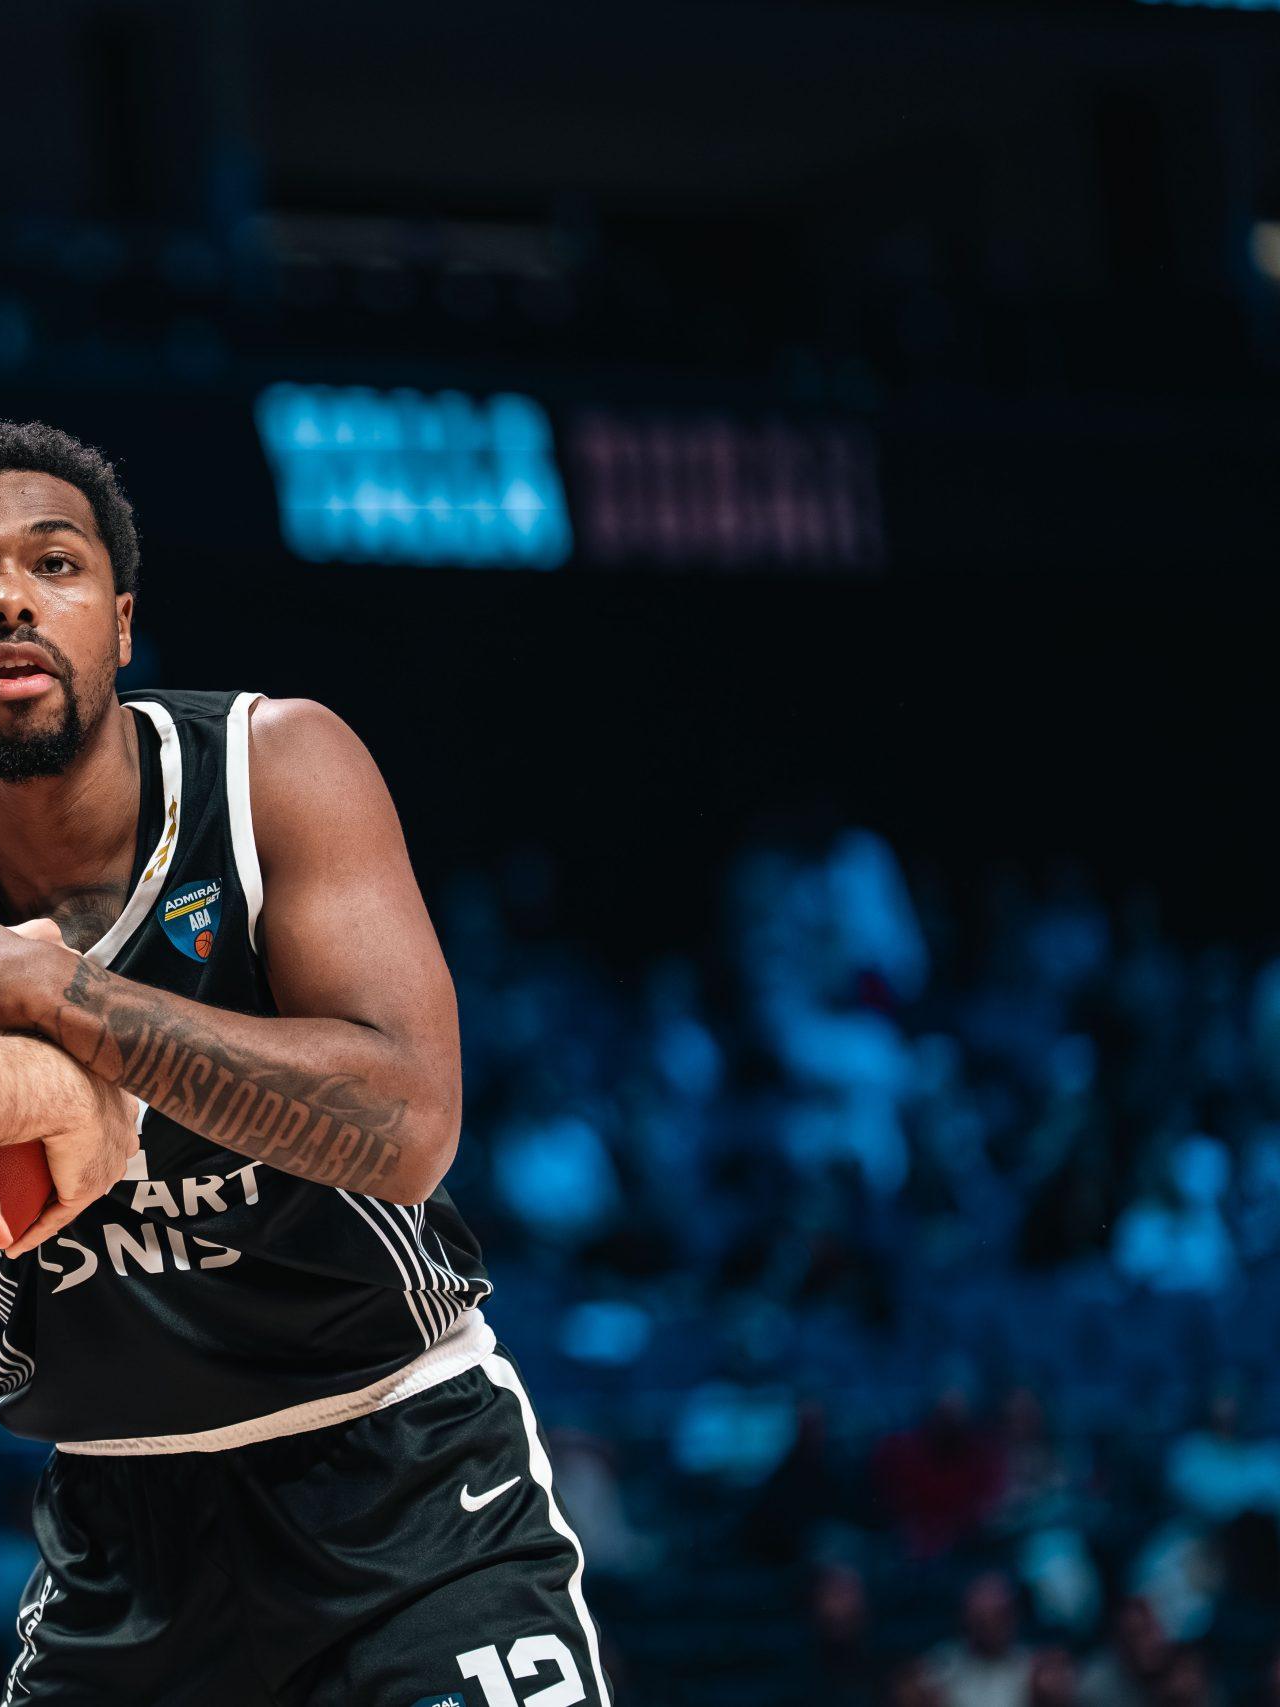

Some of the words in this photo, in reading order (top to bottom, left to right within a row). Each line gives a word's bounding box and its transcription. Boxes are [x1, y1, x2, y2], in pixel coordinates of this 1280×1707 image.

[165, 882, 221, 912] ADMIRAL
[189, 908, 211, 932] ABA
[105, 1161, 263, 1217] ART
[455, 1634, 587, 1707] 12
